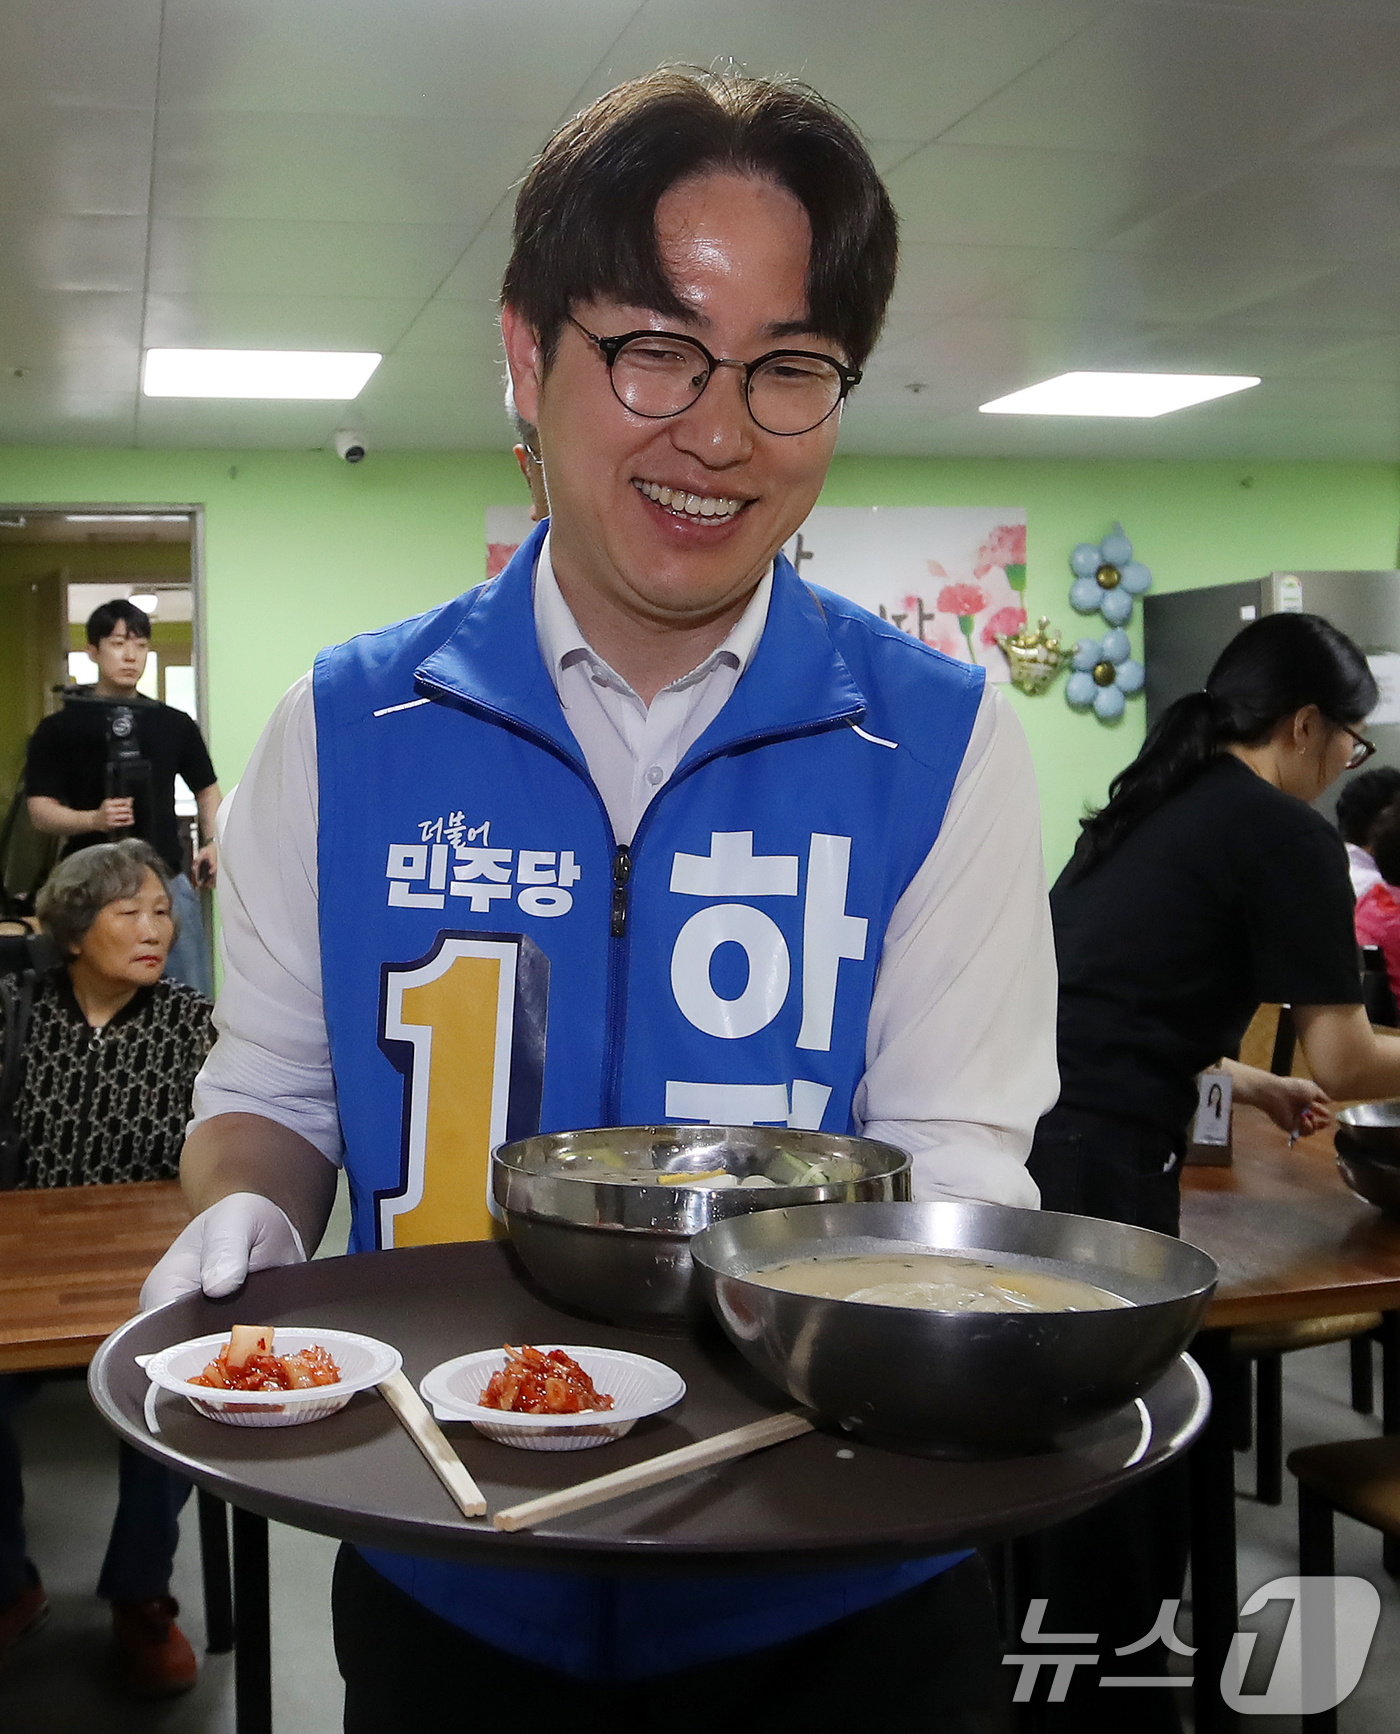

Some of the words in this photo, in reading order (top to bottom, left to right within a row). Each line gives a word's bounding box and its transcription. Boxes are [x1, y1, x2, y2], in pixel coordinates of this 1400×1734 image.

[386, 843, 582, 918] 민주당
[417, 810, 490, 850] 더불어
[664, 830, 869, 1131] 하
[375, 931, 523, 1250] 1
